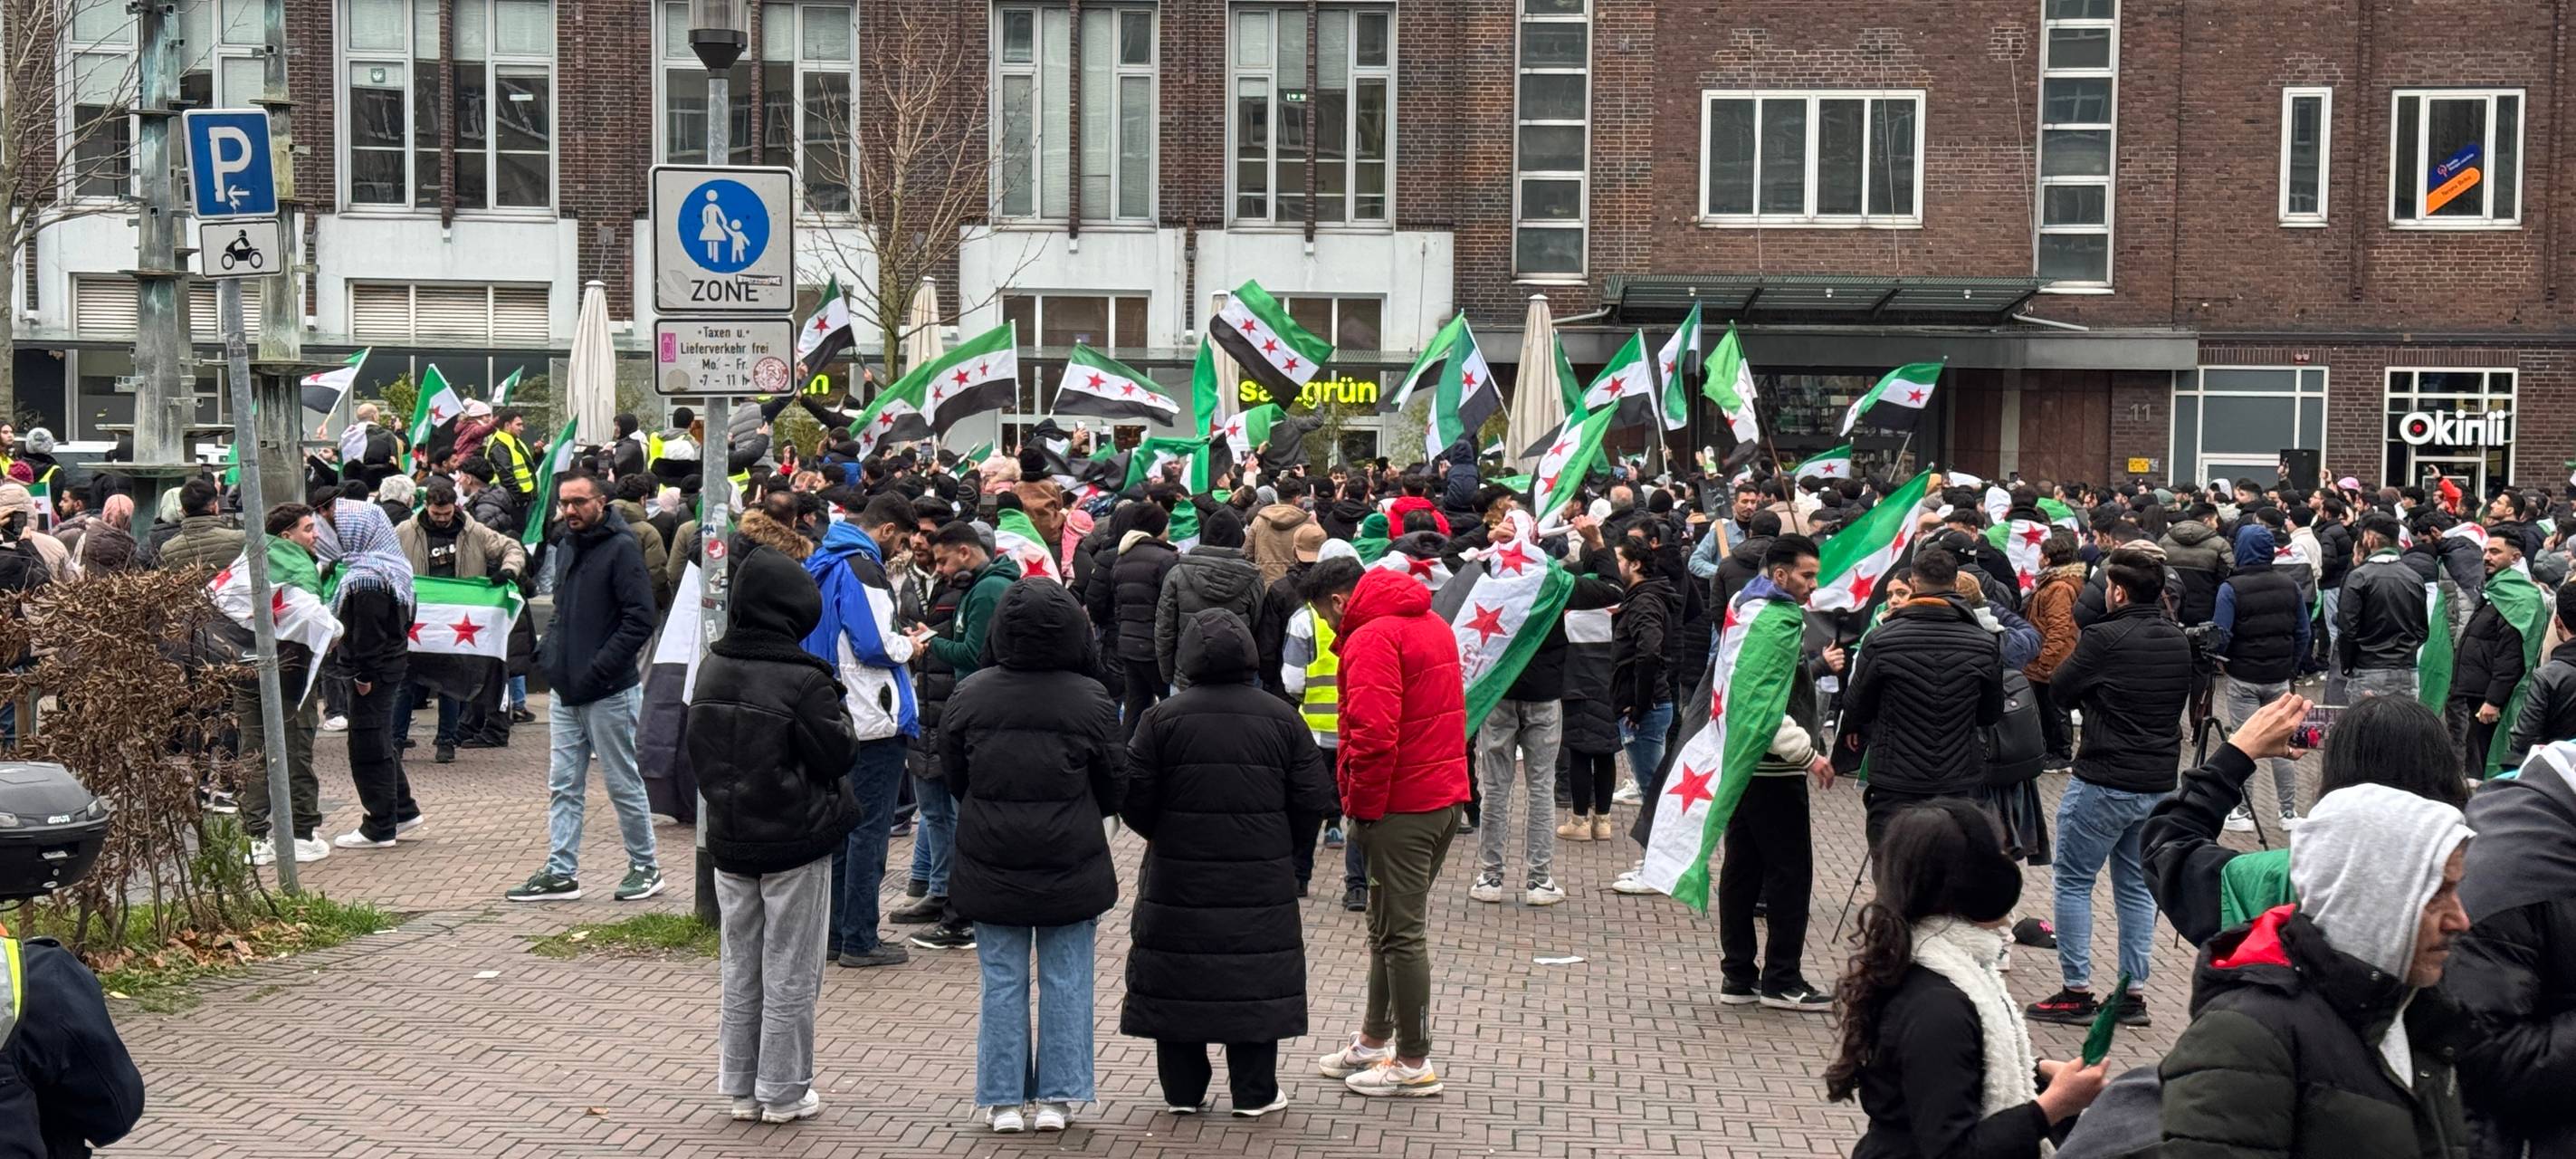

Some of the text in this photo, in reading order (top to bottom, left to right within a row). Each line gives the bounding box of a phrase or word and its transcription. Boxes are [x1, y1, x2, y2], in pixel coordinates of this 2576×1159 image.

[207, 126, 253, 203] P
[691, 280, 759, 302] ZONE
[703, 326, 731, 338] Taxen
[680, 342, 769, 354] Lieferverkehr frei
[736, 359, 749, 370] Fr.
[726, 374, 737, 387] 11
[2130, 403, 2151, 421] 11
[2399, 408, 2506, 446] Okinii
